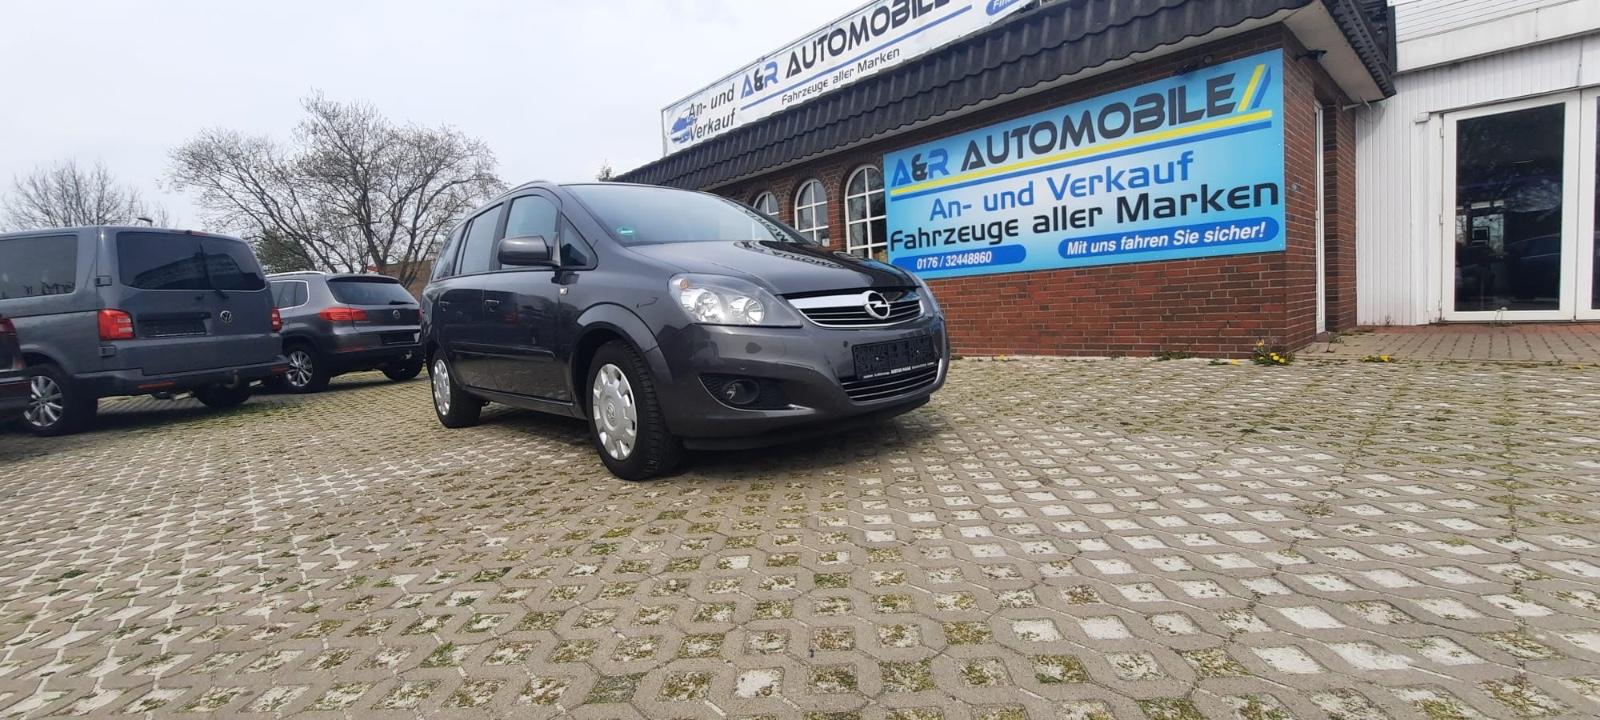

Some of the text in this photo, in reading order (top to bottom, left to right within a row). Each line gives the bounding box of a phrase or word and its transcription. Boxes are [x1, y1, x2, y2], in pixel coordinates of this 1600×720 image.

[740, 60, 778, 99] A&R
[781, 48, 901, 106] Fahrzeuge aller Marken
[688, 83, 735, 118] An- und
[688, 107, 736, 142] Verkauf
[891, 72, 1236, 188] A&R AUTOMOBILE
[929, 150, 1194, 222] An- und Verkauf
[890, 182, 1280, 253] Fahrzeuge aller Marken
[1066, 221, 1266, 257] Mit uns fahren Sie sicher!
[916, 257, 938, 269] 0176
[945, 251, 993, 267] 32448860
